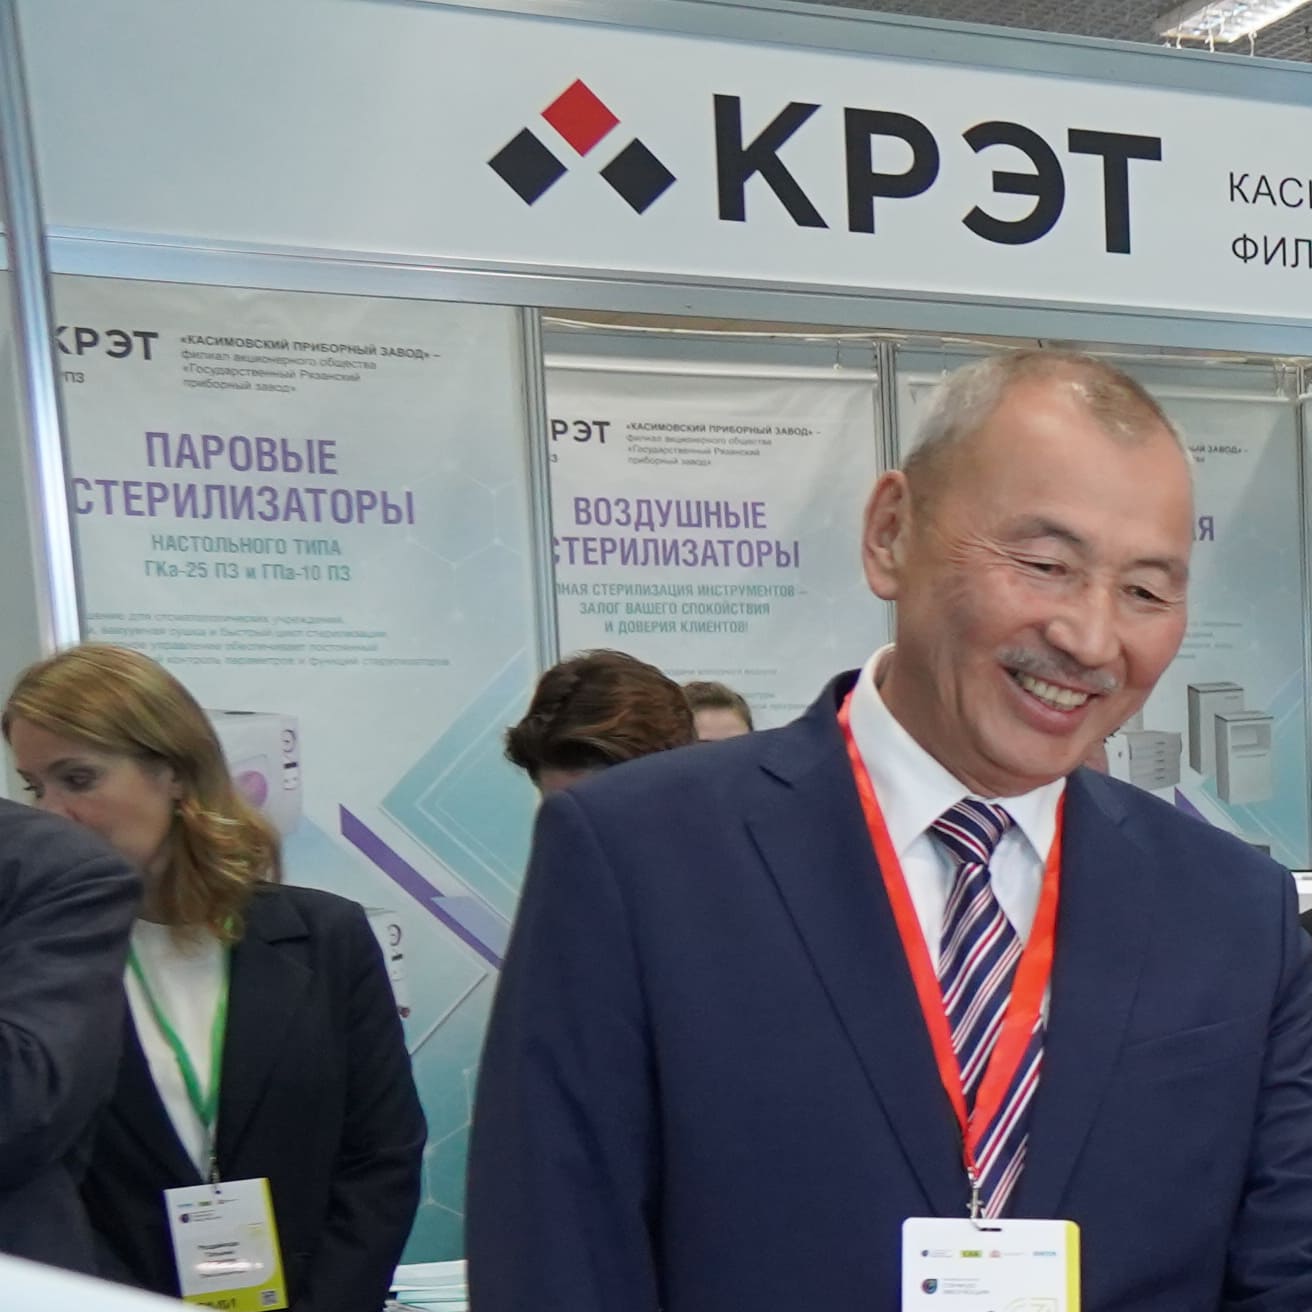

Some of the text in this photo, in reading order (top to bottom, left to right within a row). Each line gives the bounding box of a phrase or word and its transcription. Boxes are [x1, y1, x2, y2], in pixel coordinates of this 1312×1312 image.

[712, 93, 1162, 255] КРЭТ
[292, 341, 377, 357] ПРИБОРНЫЙ
[63, 369, 86, 385] ПЗ
[550, 418, 611, 444] РЭТ
[145, 431, 338, 475] ПАРОВЫЕ
[71, 477, 416, 526] СТЕРИЛИЗАТОРЫ
[573, 496, 768, 533] ВОЗДУШНЫЕ
[151, 534, 342, 557] НАСТОЛЬНОГО ТИПА
[591, 583, 695, 599] СТЕРИЛИЗАЦИЯ
[697, 584, 796, 600] ИНСТРУМЕНТОВ
[579, 601, 771, 617] ЗАЛОГ ВАШЕГО СПОКОЙСТВИЯ
[617, 620, 677, 635] ДОВЕРИЯ
